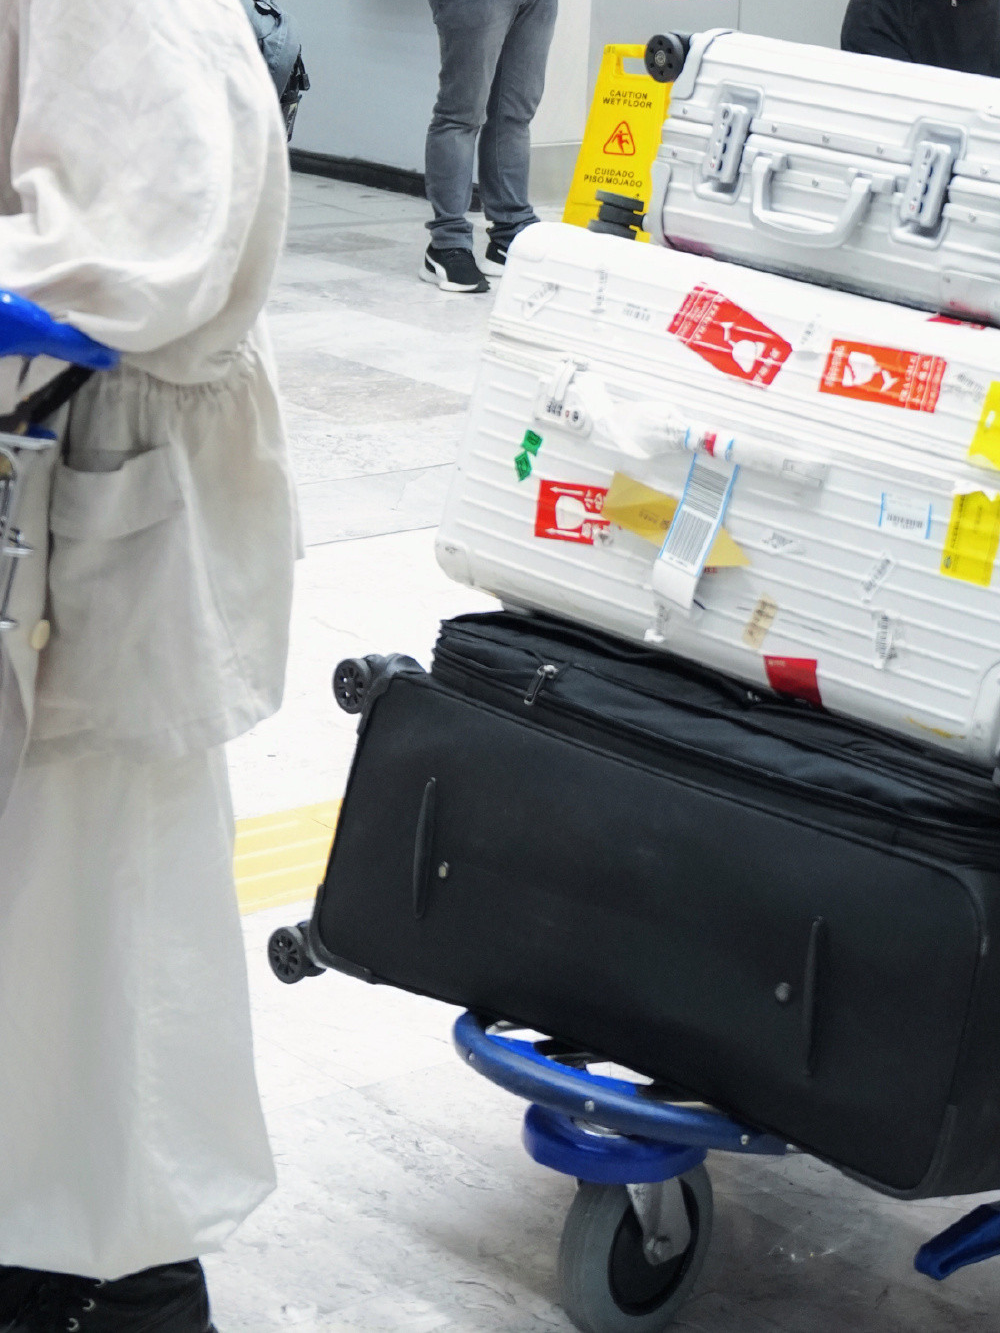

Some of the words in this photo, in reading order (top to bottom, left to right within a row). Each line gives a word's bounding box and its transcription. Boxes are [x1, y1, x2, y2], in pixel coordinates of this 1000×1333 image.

[609, 89, 648, 100] CAUTION
[602, 98, 621, 106] WET
[622, 99, 652, 109] FLOOR
[594, 167, 635, 178] CUIDADO
[584, 174, 604, 183] PISO
[605, 177, 643, 187] MOJADO
